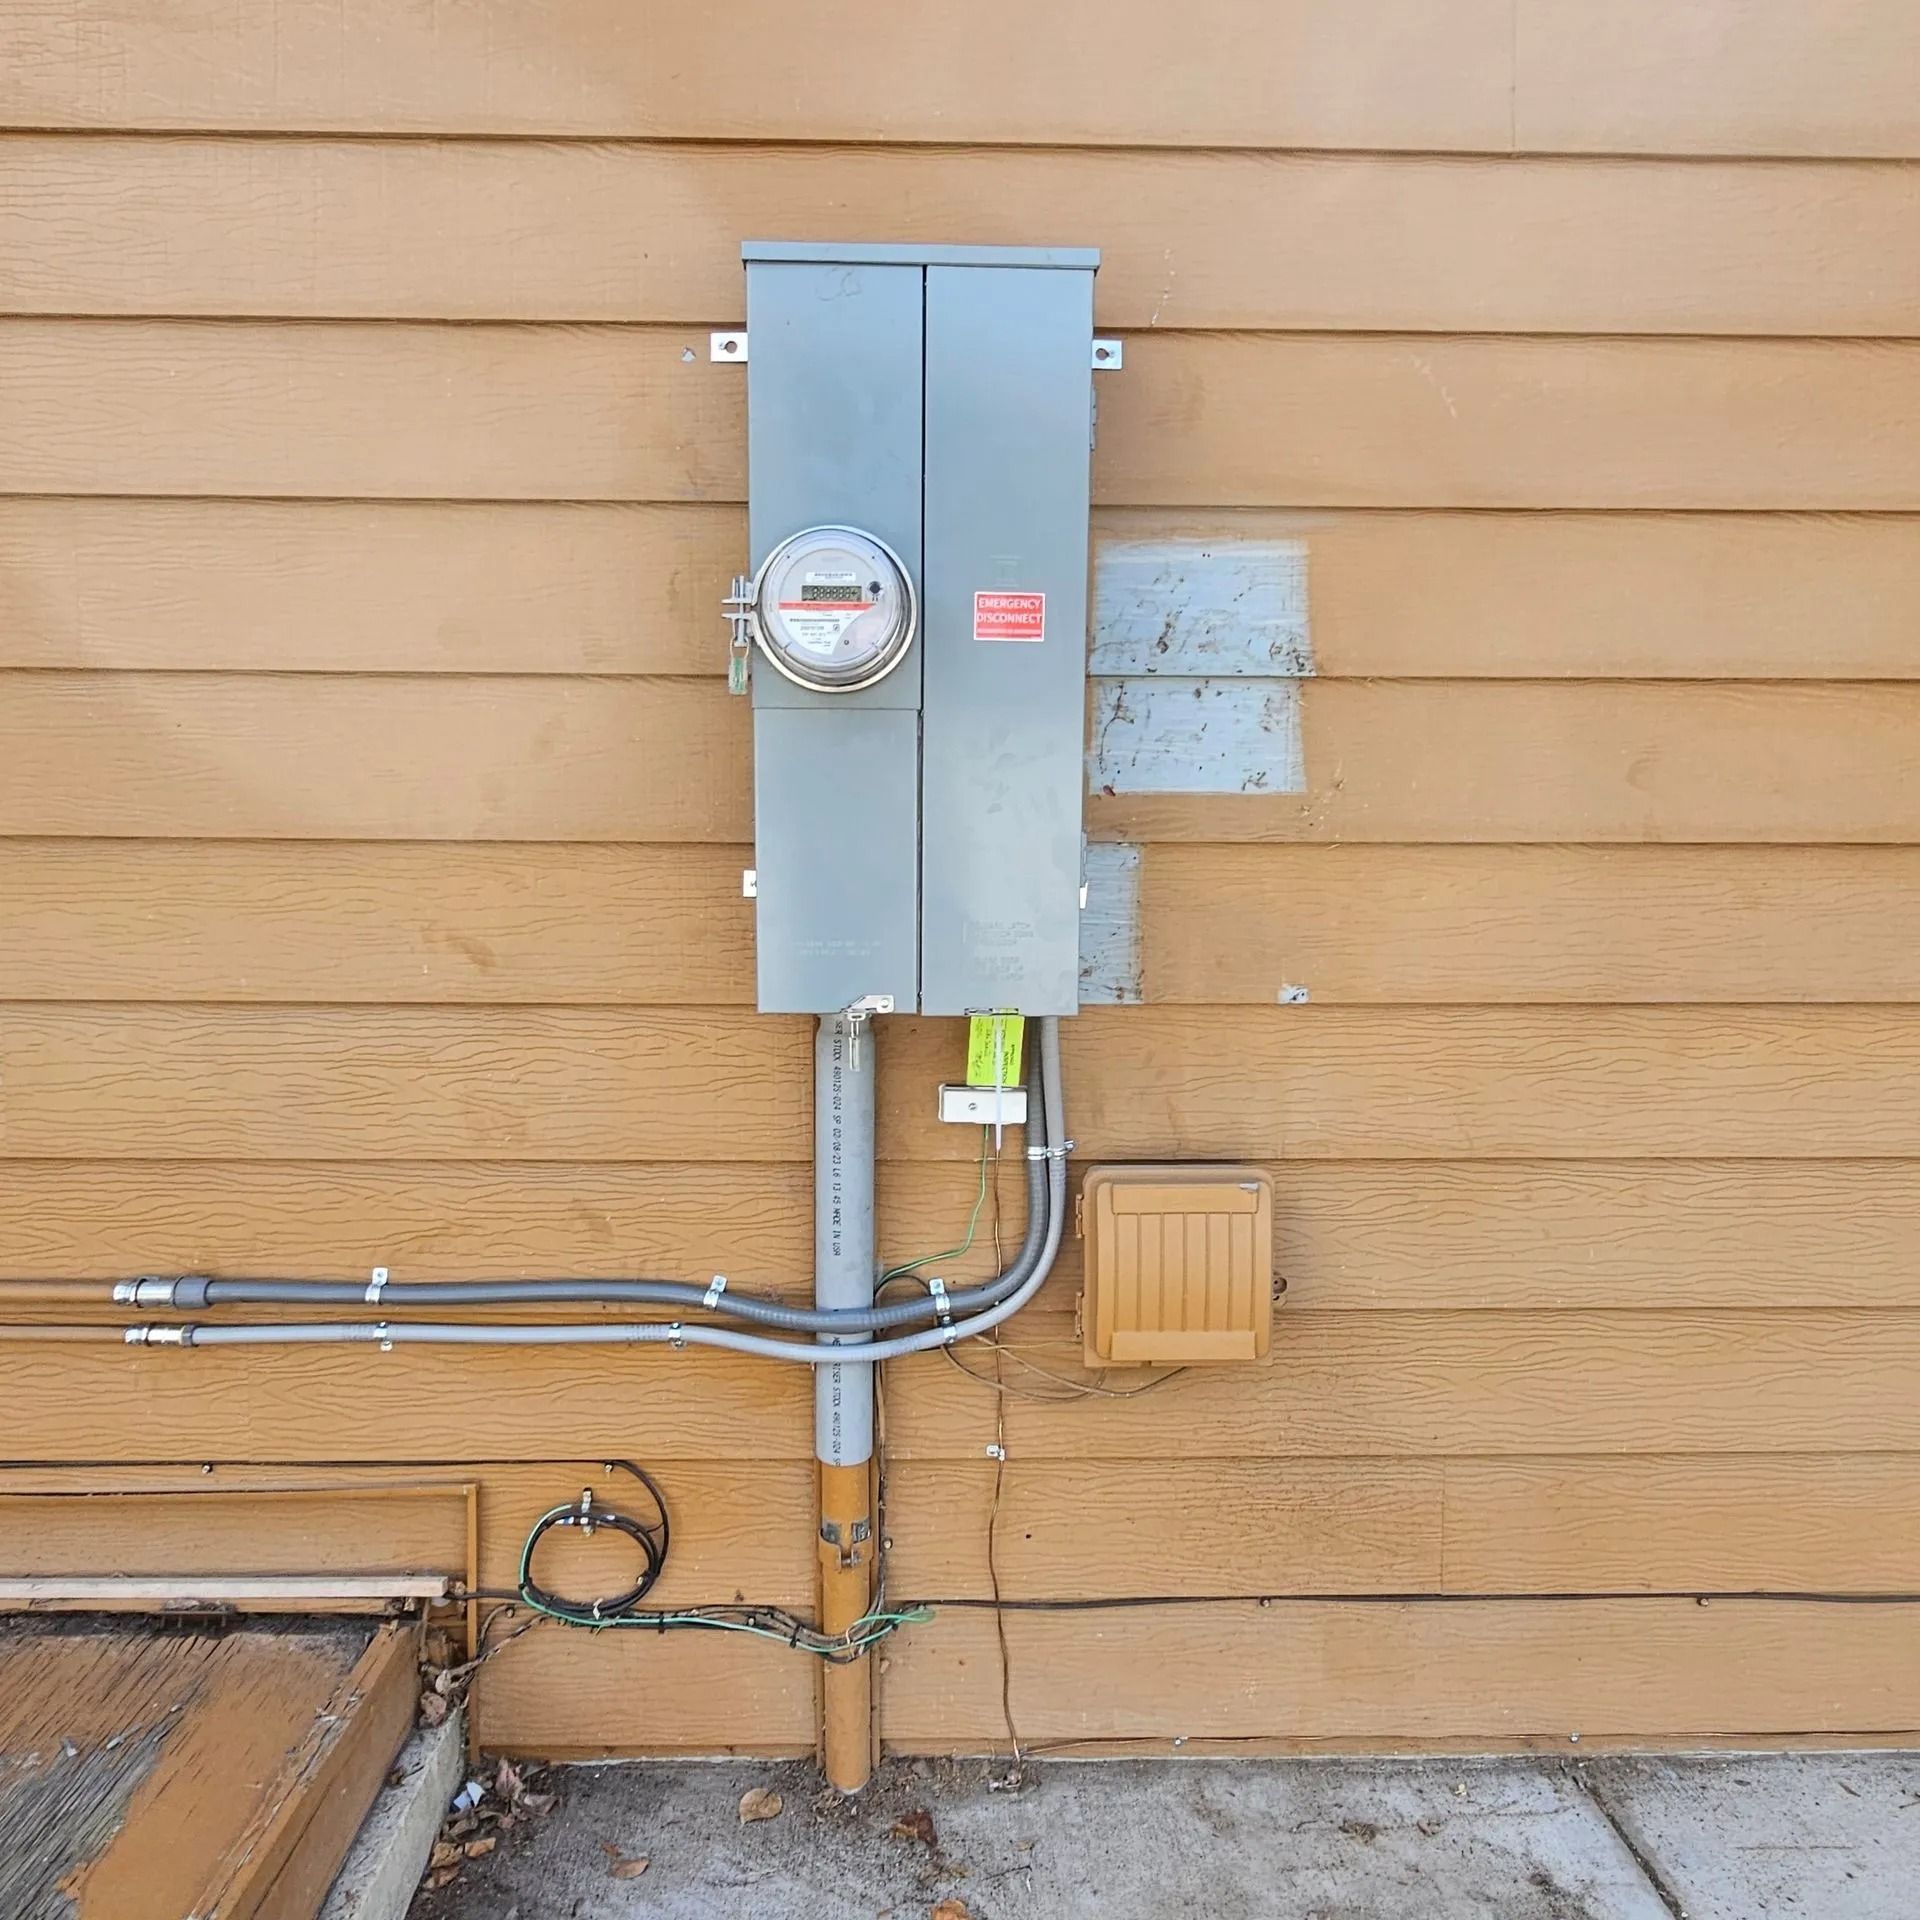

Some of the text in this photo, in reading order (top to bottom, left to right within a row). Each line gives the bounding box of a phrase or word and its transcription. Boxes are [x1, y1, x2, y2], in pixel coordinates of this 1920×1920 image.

[978, 597, 1041, 609] EMERGENCY
[977, 613, 1042, 624] DISCONNECT
[833, 1020, 843, 1035] SER
[833, 1039, 843, 1062] STOCK
[833, 1208, 842, 1226] MADE
[833, 1230, 842, 1239] IN
[833, 1242, 842, 1256] USA
[833, 1387, 841, 1407] STOCK
